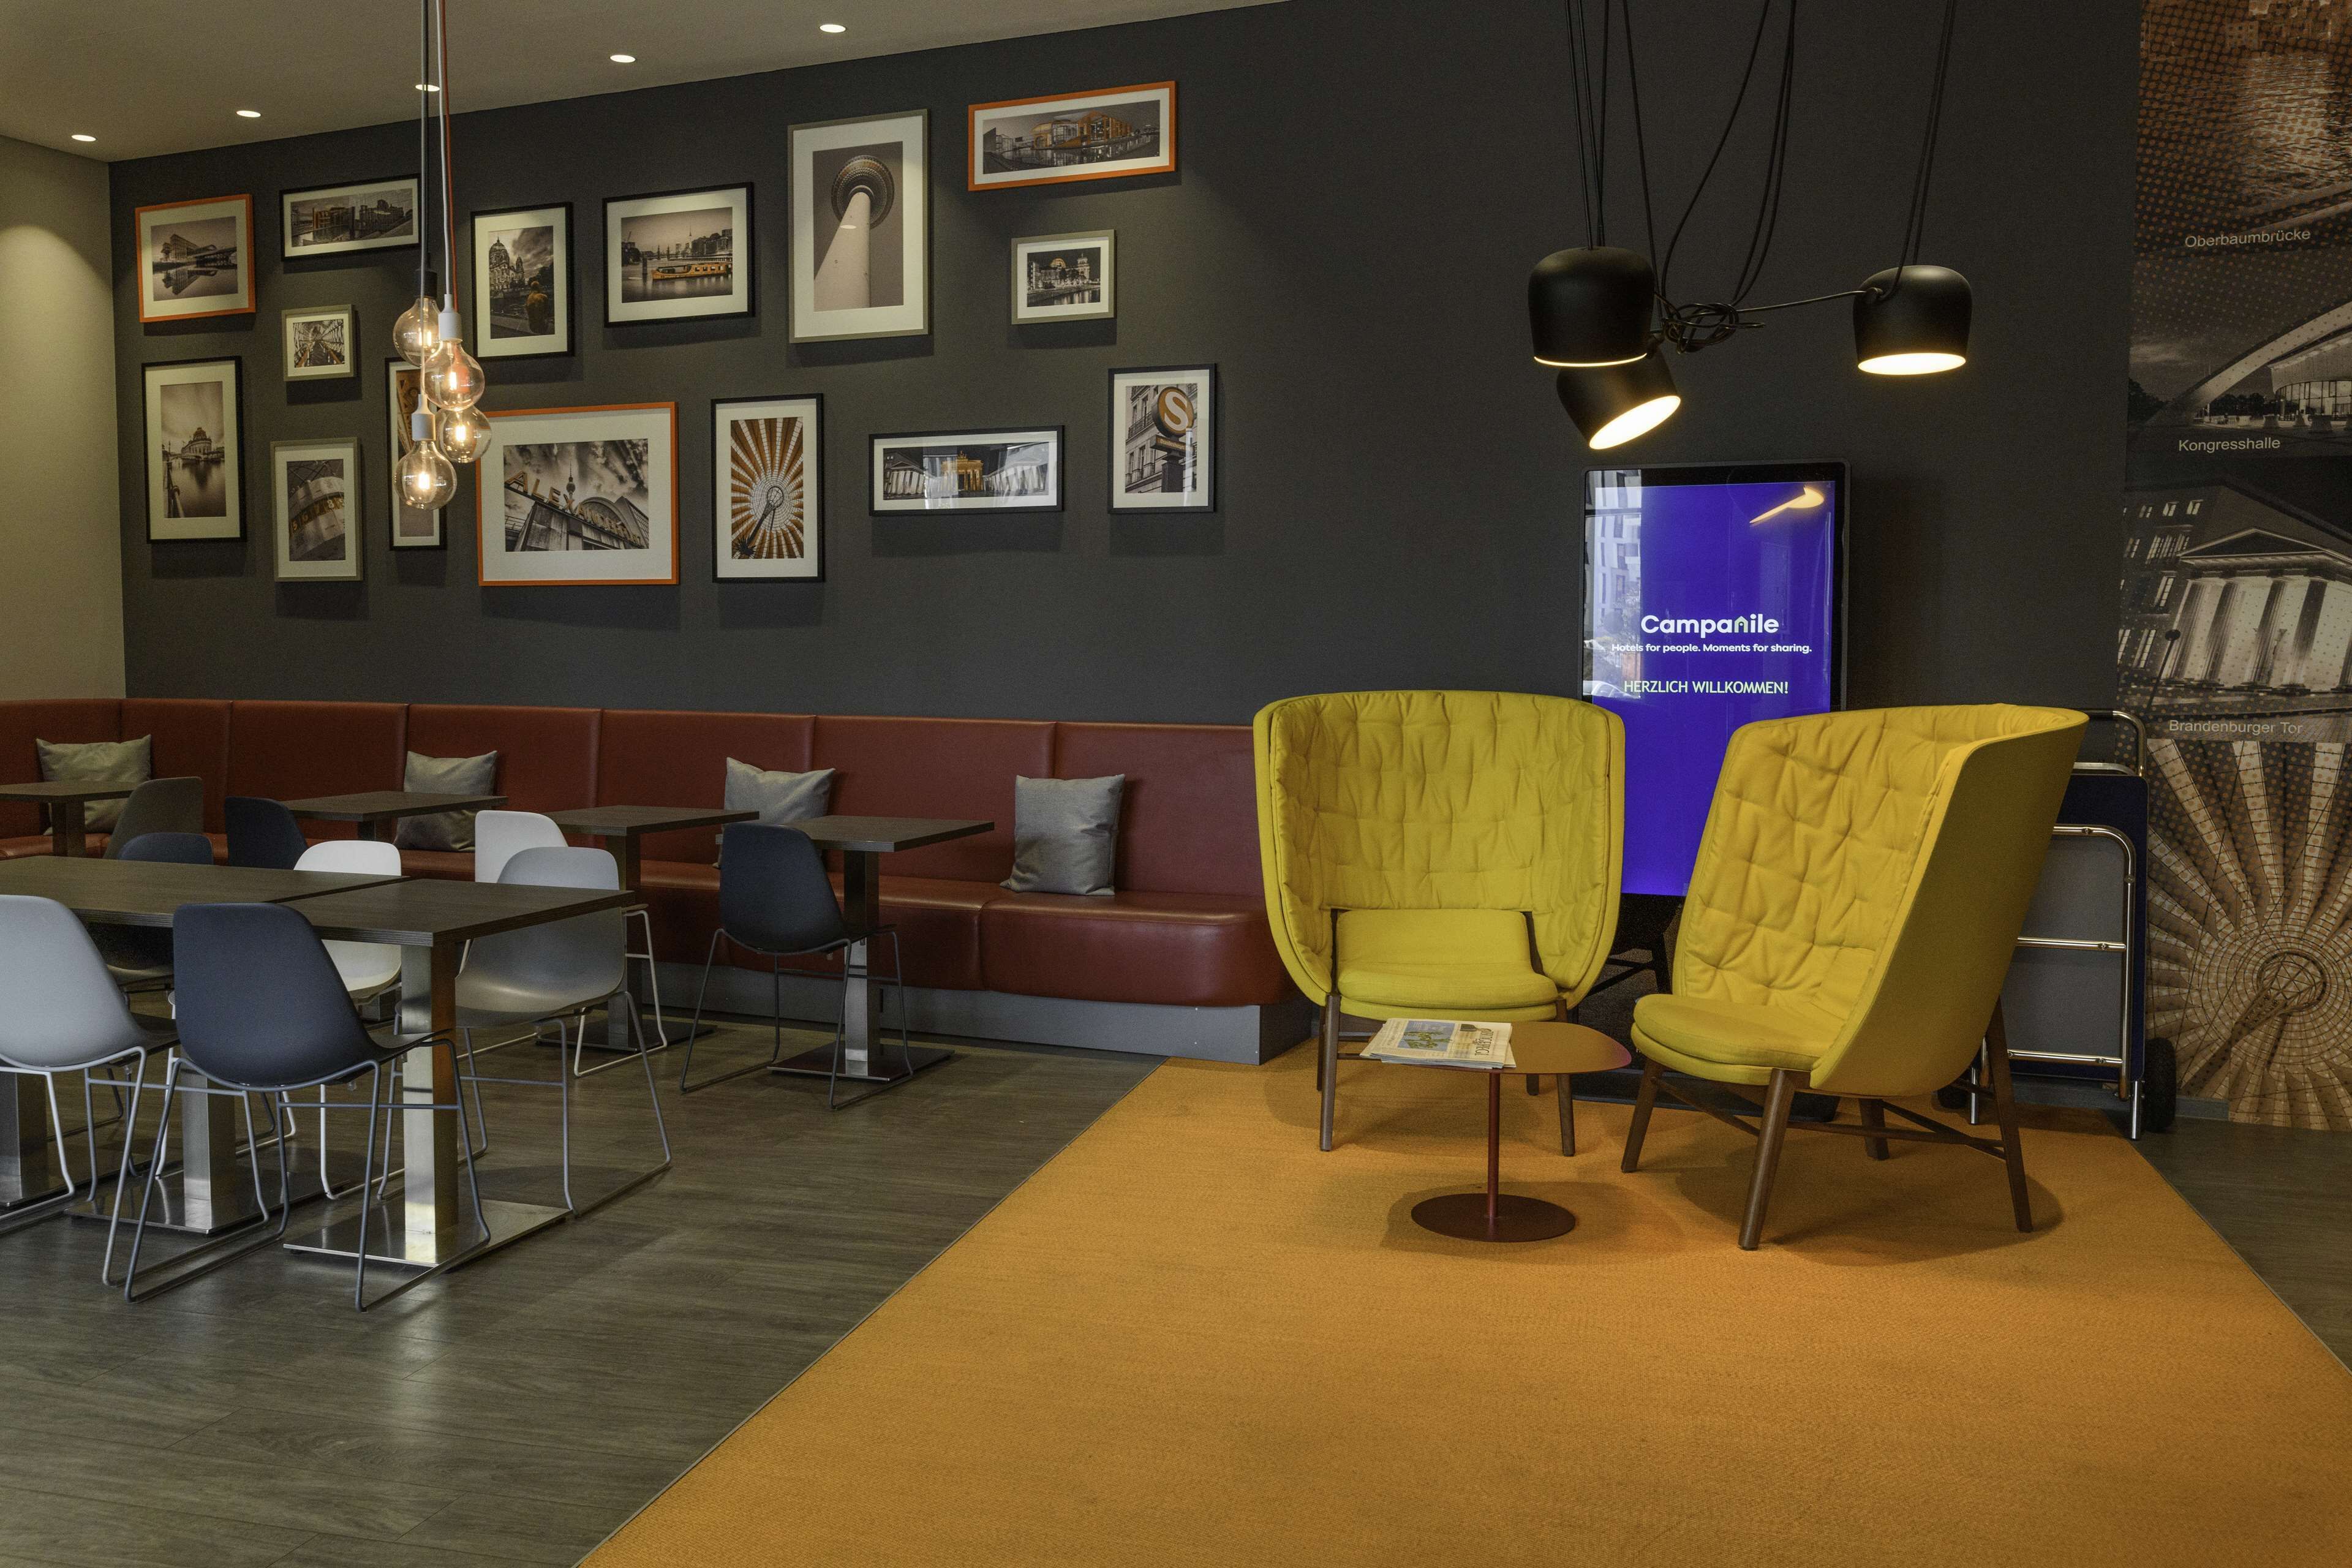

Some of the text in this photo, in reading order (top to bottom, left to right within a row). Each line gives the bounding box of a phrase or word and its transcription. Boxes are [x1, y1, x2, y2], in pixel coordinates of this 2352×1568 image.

[2185, 230, 2311, 247] Oberbaumbrücke
[1164, 391, 1188, 431] S
[2179, 437, 2281, 453] Kongresshalle
[1641, 614, 1779, 639] Campanile
[1663, 644, 1701, 654] people.
[1771, 644, 1812, 654] sharing.
[1624, 680, 1789, 694] HERZLICH WILLKOMMEN!
[2169, 720, 2303, 735] Brandenburger Tor
